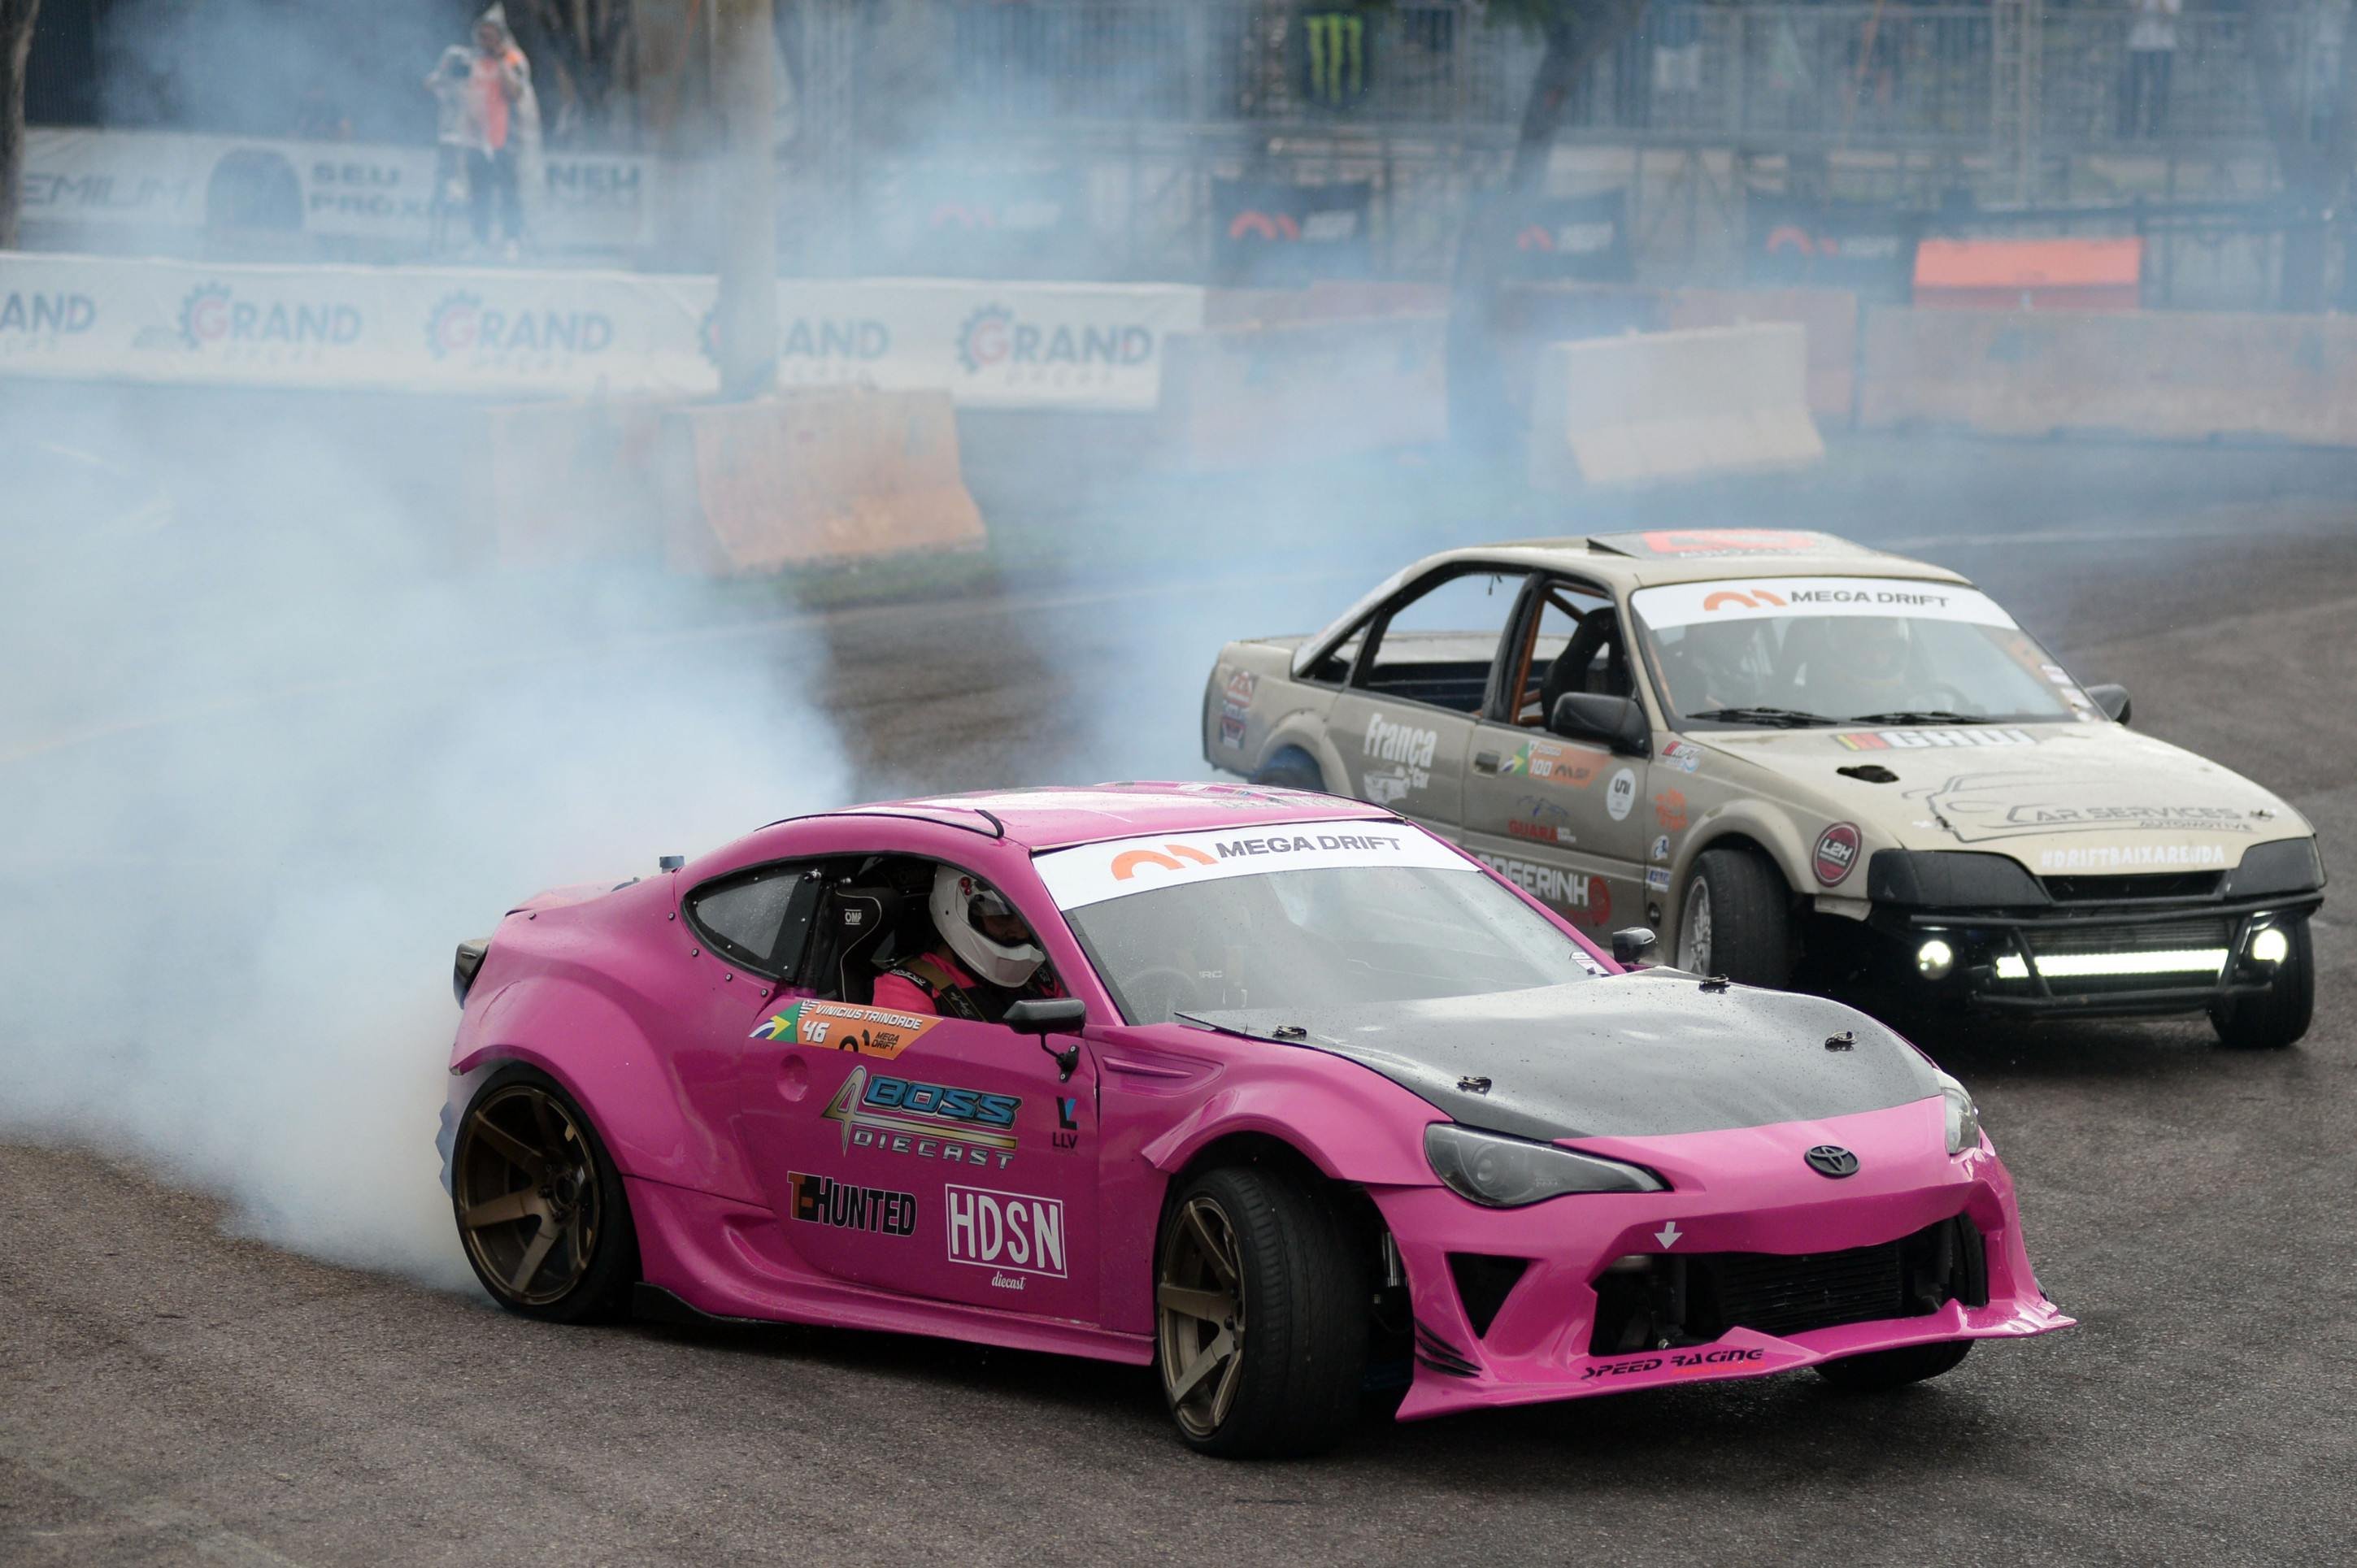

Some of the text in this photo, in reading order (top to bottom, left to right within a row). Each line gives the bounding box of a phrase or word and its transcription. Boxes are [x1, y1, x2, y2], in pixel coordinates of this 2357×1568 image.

[975, 319, 1155, 366] GRAND
[1791, 590, 1950, 607] MEGA DRIFT
[2085, 806, 2243, 819] SERVICES
[1215, 835, 1401, 858] MEGA DRIFT
[1820, 839, 1854, 861] L2H
[845, 910, 862, 923] OMP
[815, 1004, 924, 1031] VINICIUS TRINDADE
[802, 1020, 830, 1044] 46
[876, 1032, 900, 1043] MEGA
[872, 1039, 898, 1051] DRIFT
[852, 1129, 1015, 1170] DIECAST
[1052, 1132, 1078, 1149] LLV
[950, 1192, 1062, 1270] HDSN
[991, 1270, 1027, 1291] diecast
[1581, 1358, 1663, 1380] SPEED
